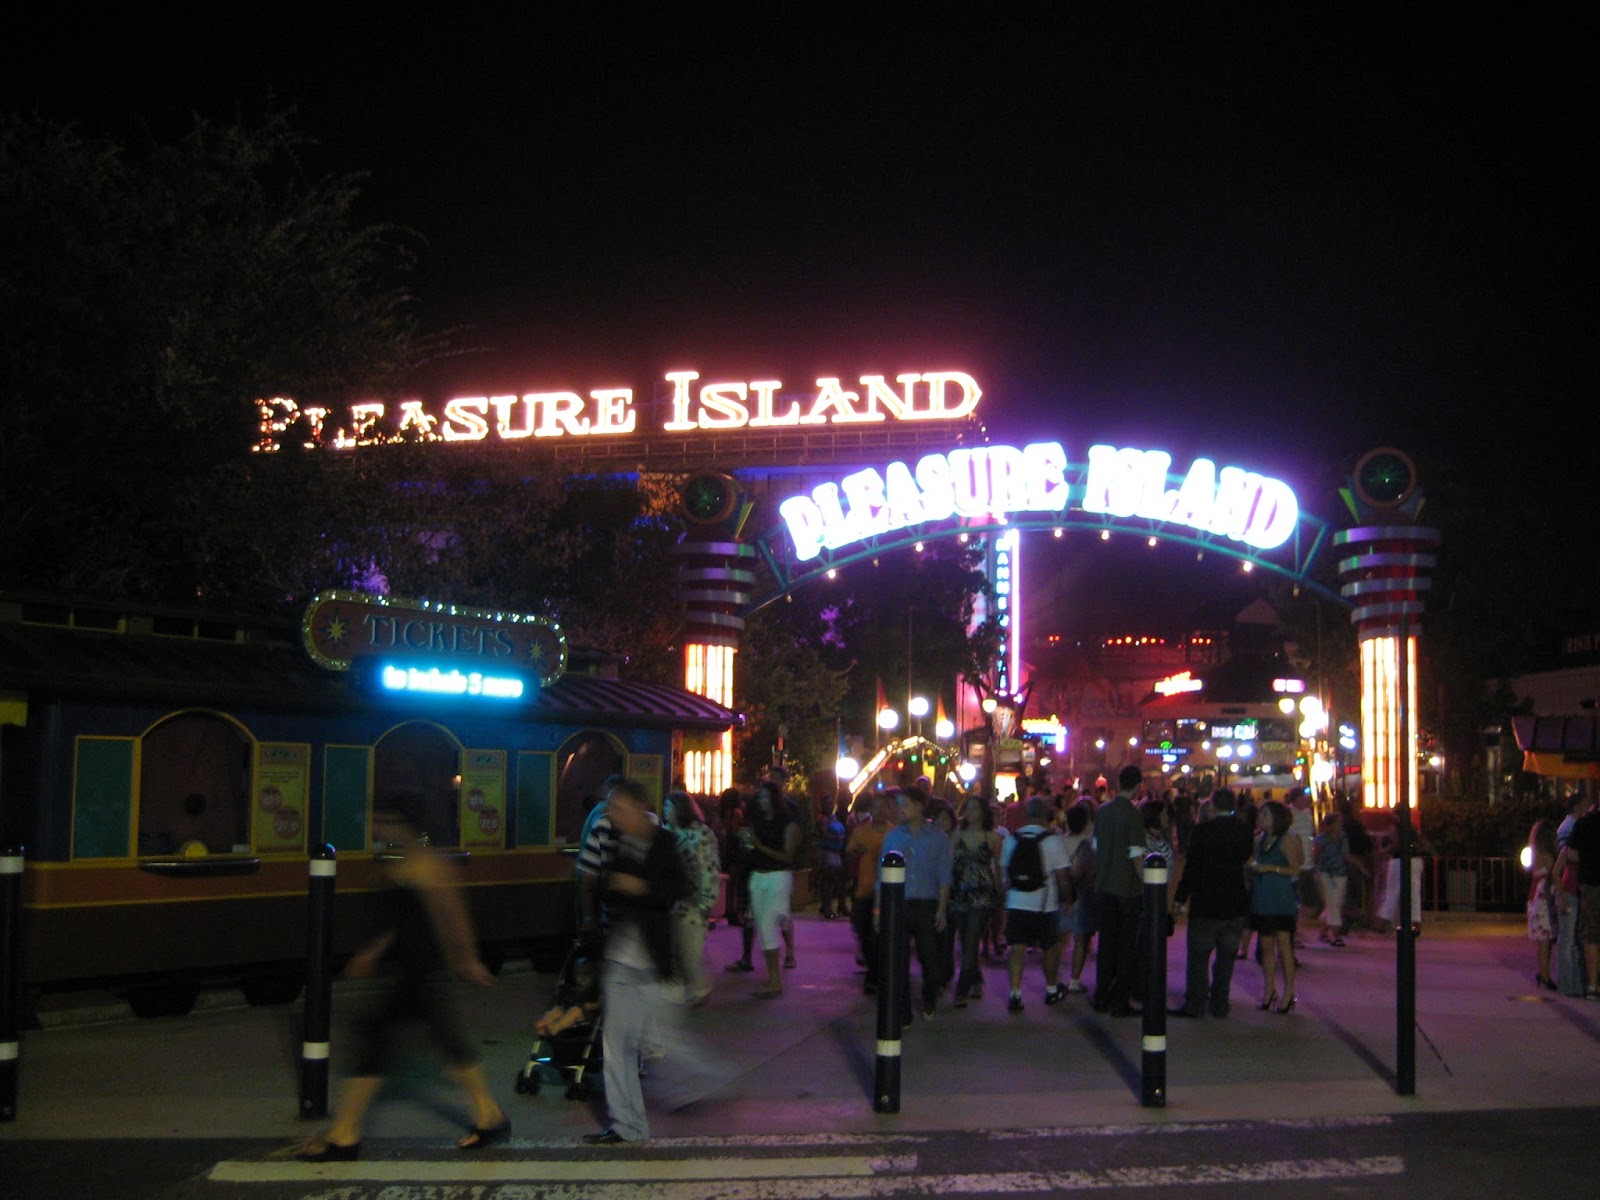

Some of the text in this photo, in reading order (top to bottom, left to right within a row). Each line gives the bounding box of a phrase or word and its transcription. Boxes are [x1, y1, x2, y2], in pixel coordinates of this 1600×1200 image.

[251, 370, 983, 451] PLEASURE ISLAND
[778, 441, 1300, 562] PLEASURE ISLAND
[363, 614, 512, 657] TICKETS
